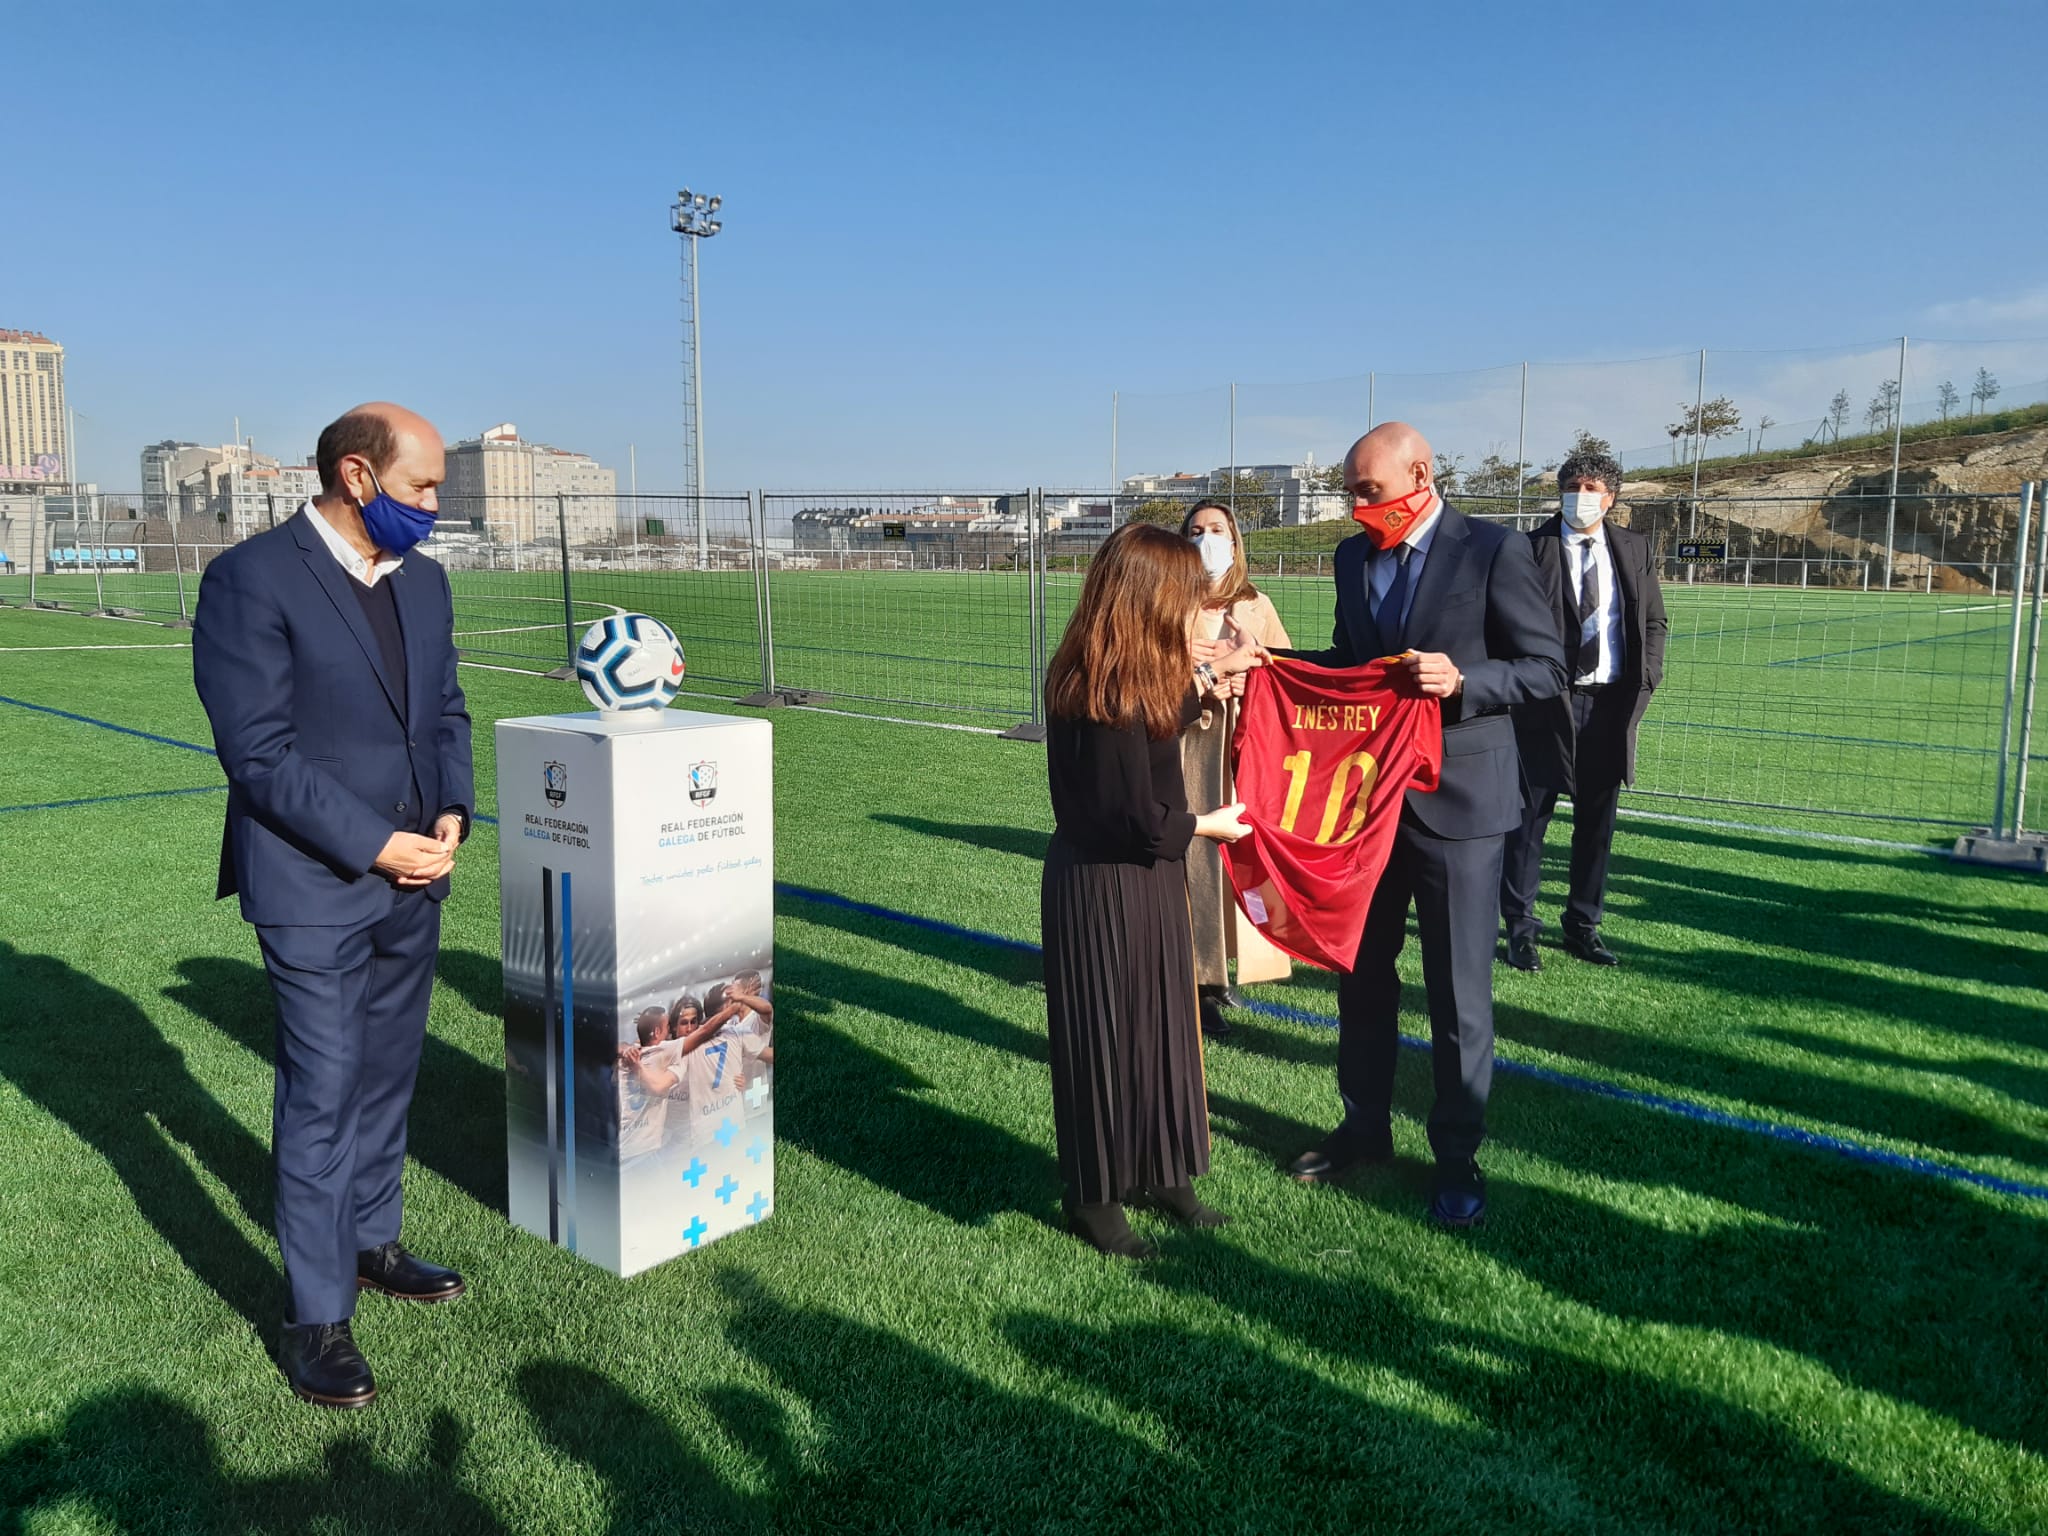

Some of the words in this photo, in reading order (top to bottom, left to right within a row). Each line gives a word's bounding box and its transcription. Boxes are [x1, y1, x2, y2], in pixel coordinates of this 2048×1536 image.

[1292, 699, 1338, 730] INÉS
[1344, 705, 1382, 732] REY
[1279, 750, 1379, 846] 10
[525, 814, 543, 826] REAL
[544, 817, 589, 835] FEDERACIÓN
[661, 821, 685, 834] REAL
[687, 811, 744, 830] FEDERACIÓN
[524, 827, 551, 840] GALEGA
[552, 832, 562, 843] DE
[563, 833, 591, 849] FÚTBOL
[658, 834, 696, 848] GALEGA
[697, 832, 709, 842] DE
[711, 825, 746, 839] FÚTBOL
[704, 1040, 728, 1090] 7
